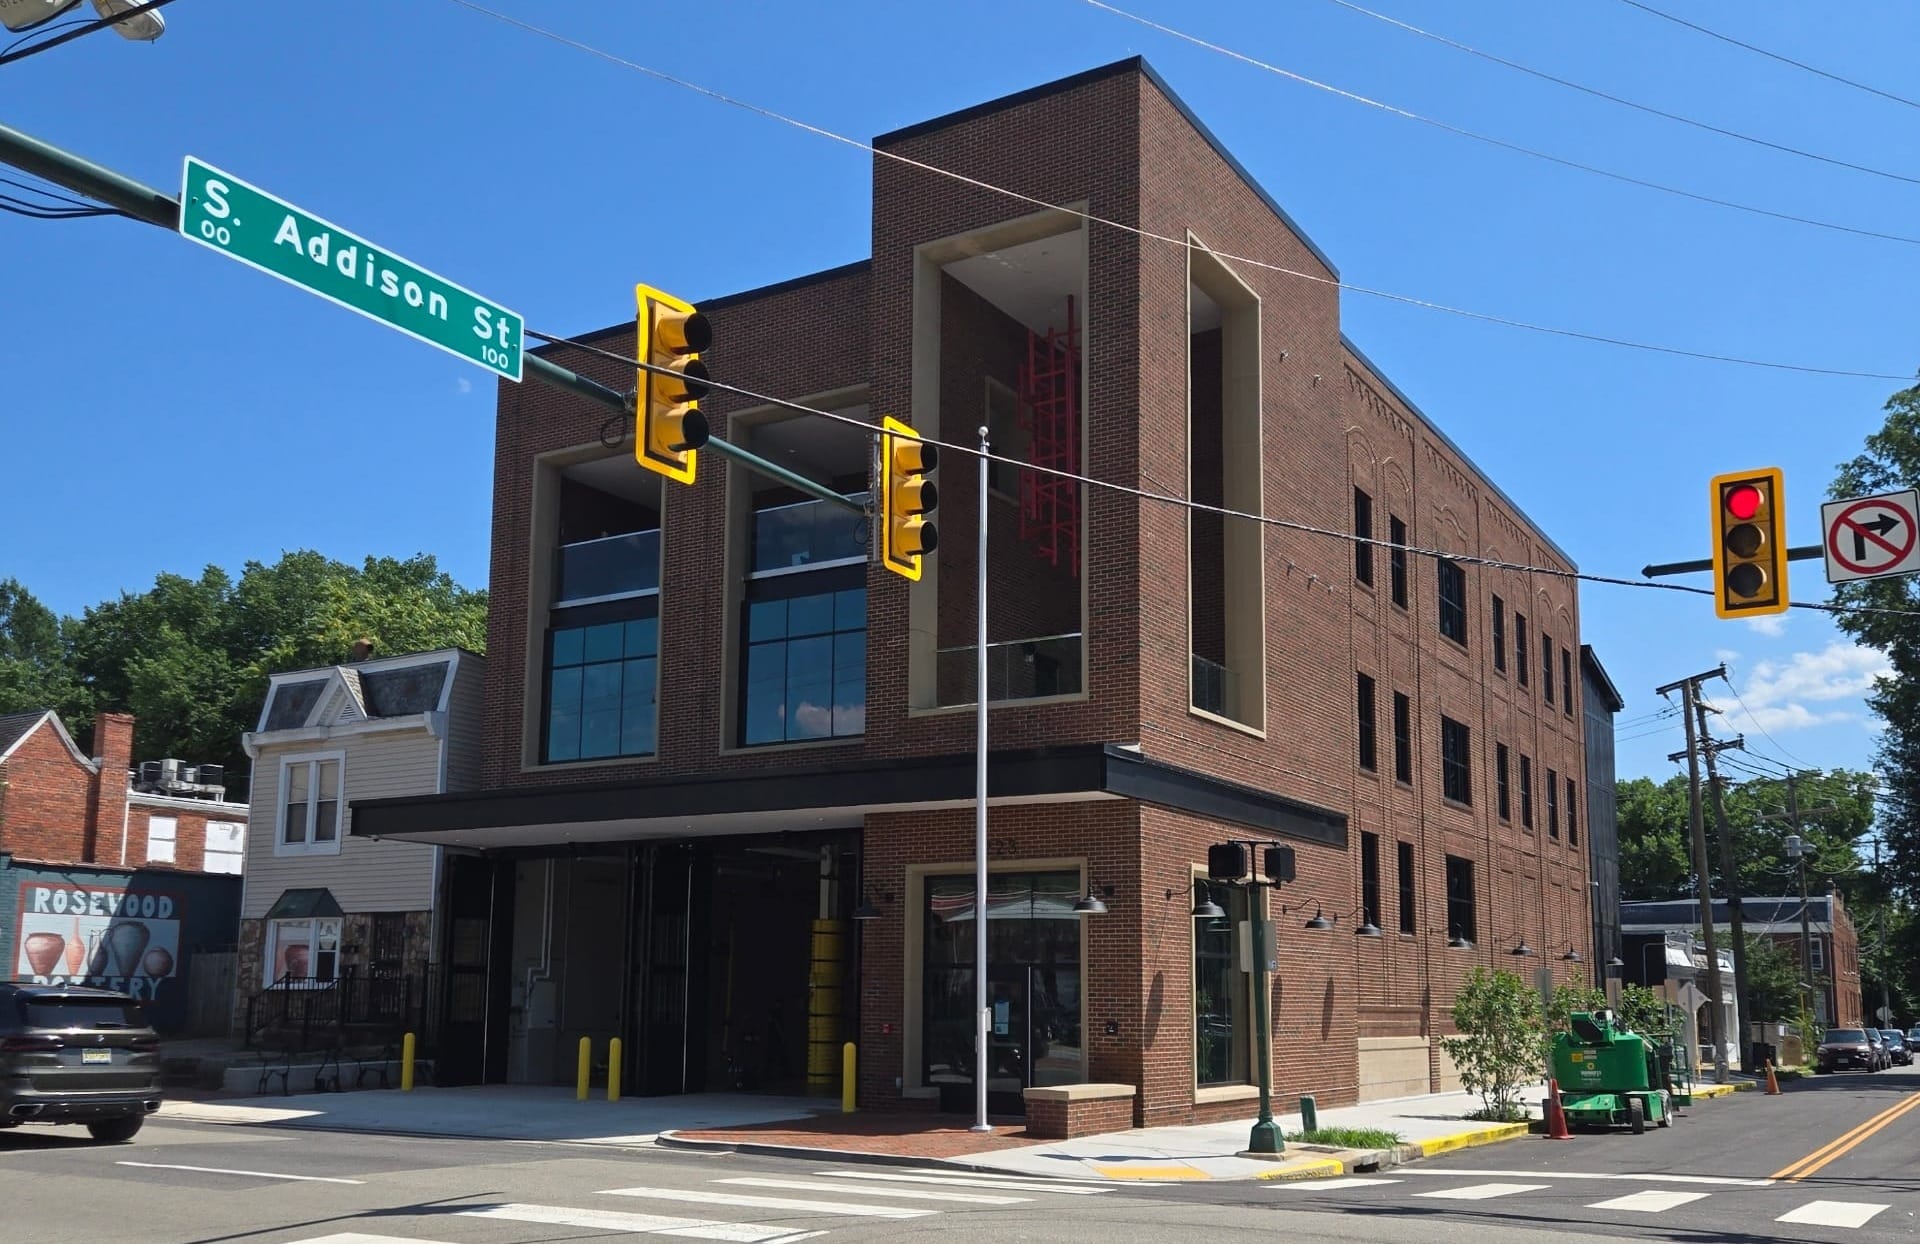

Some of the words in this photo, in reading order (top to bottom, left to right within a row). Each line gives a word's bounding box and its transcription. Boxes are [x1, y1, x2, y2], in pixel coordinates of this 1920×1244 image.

[200, 219, 231, 246] 00
[203, 179, 241, 227] S.
[274, 214, 448, 321] Addison
[472, 306, 511, 349] St
[481, 344, 509, 369] 100
[34, 888, 173, 918] ROSEWOOD
